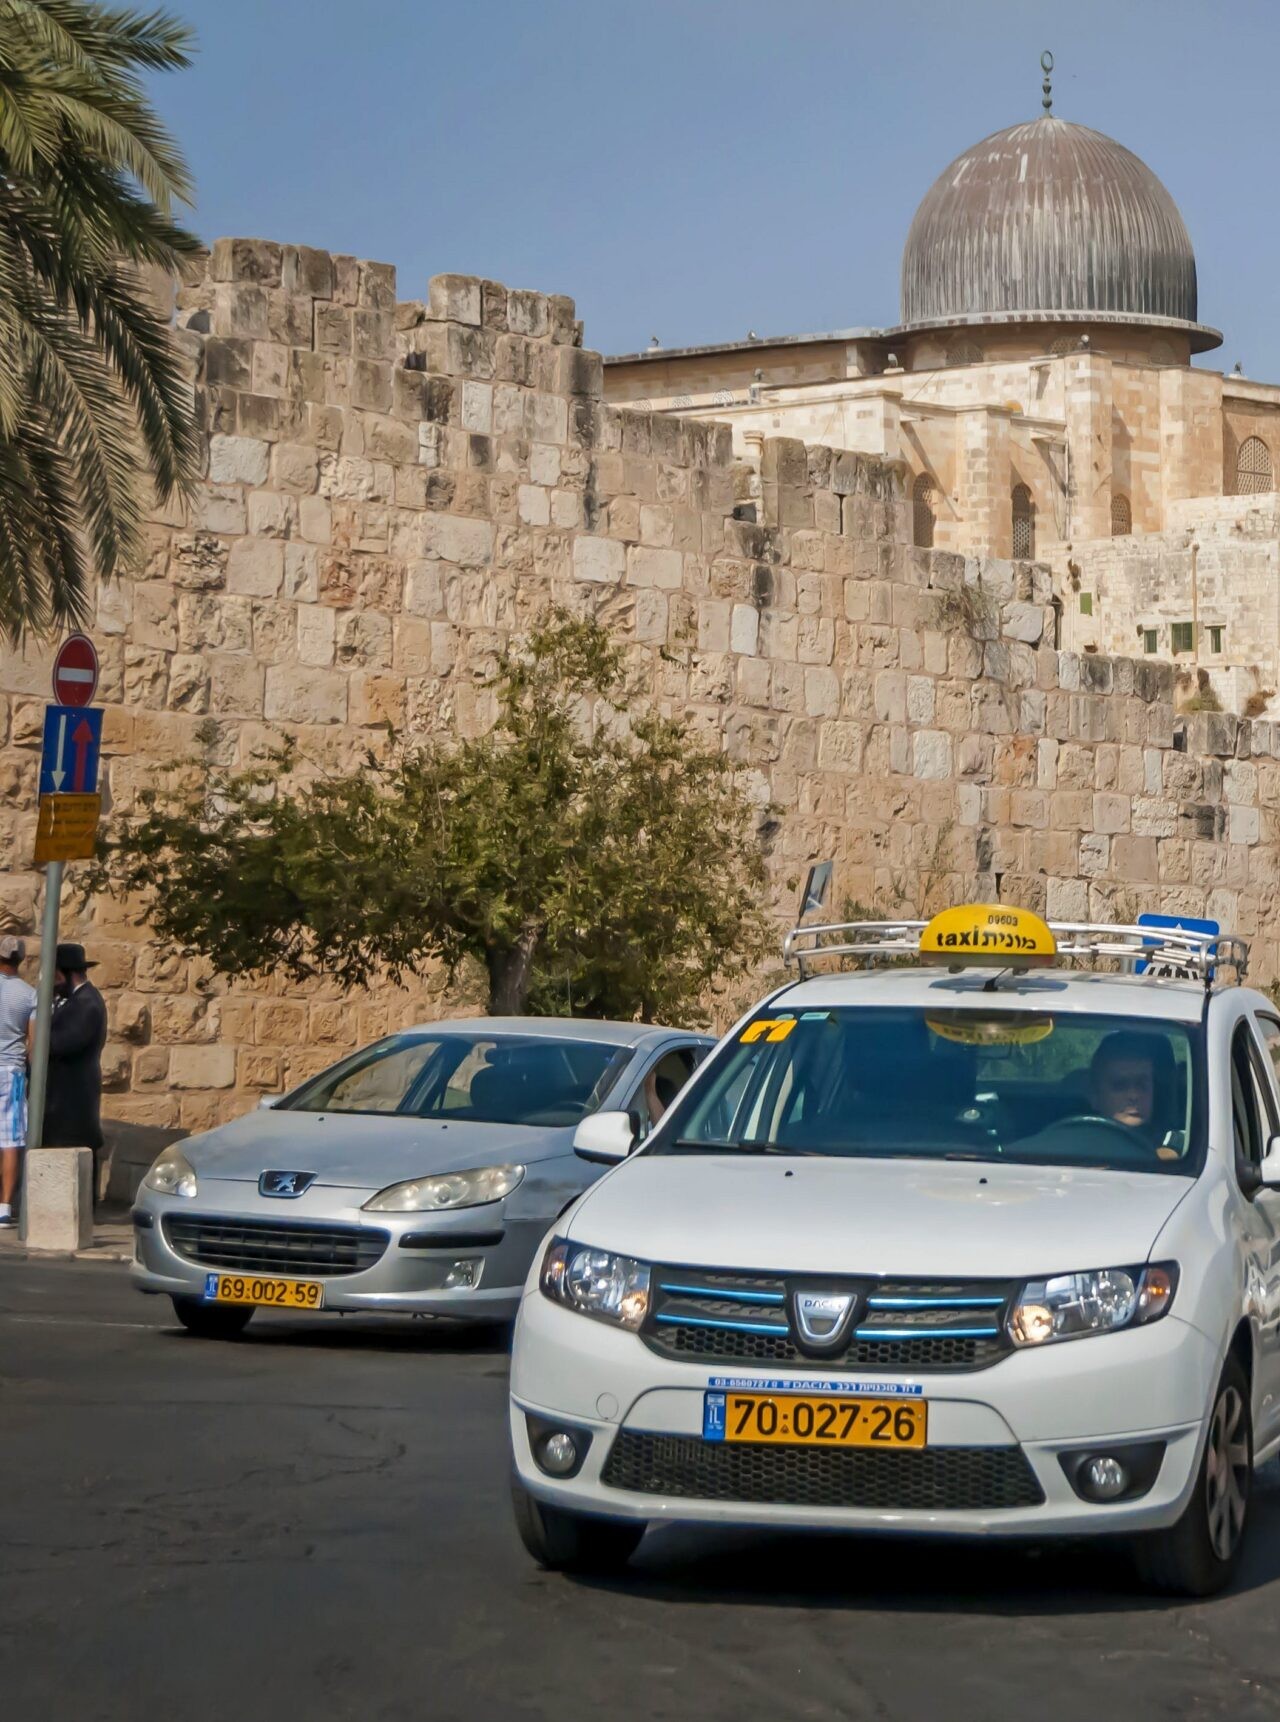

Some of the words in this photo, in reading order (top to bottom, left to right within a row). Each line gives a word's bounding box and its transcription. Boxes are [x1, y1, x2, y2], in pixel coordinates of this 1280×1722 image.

[936, 925, 979, 947] taxi
[981, 931, 1037, 950] מונית
[792, 1380, 832, 1390] DACIA
